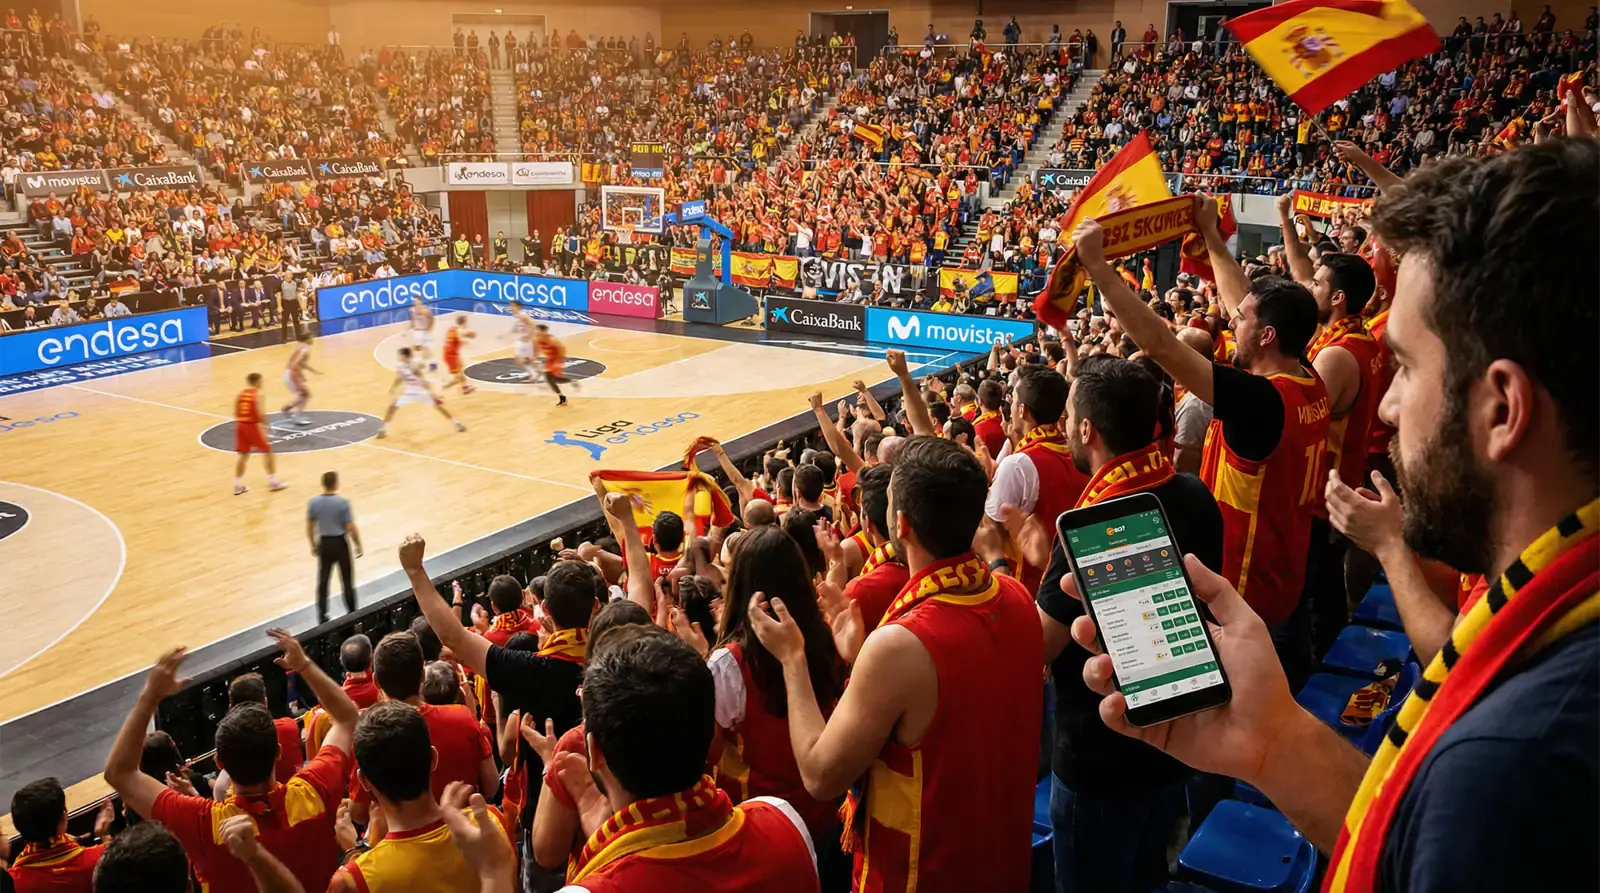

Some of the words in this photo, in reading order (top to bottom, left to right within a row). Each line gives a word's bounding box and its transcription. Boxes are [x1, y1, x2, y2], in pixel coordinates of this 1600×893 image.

[134, 171, 198, 187] CaixaBank
[263, 166, 308, 178] CaixaBank
[332, 162, 380, 175] CaixaBank
[48, 175, 101, 187] movistar
[341, 279, 438, 313] endesa
[472, 275, 566, 306] endesa
[592, 286, 654, 307] endesa
[790, 309, 862, 331] CaixaBank
[37, 318, 183, 365] endesa
